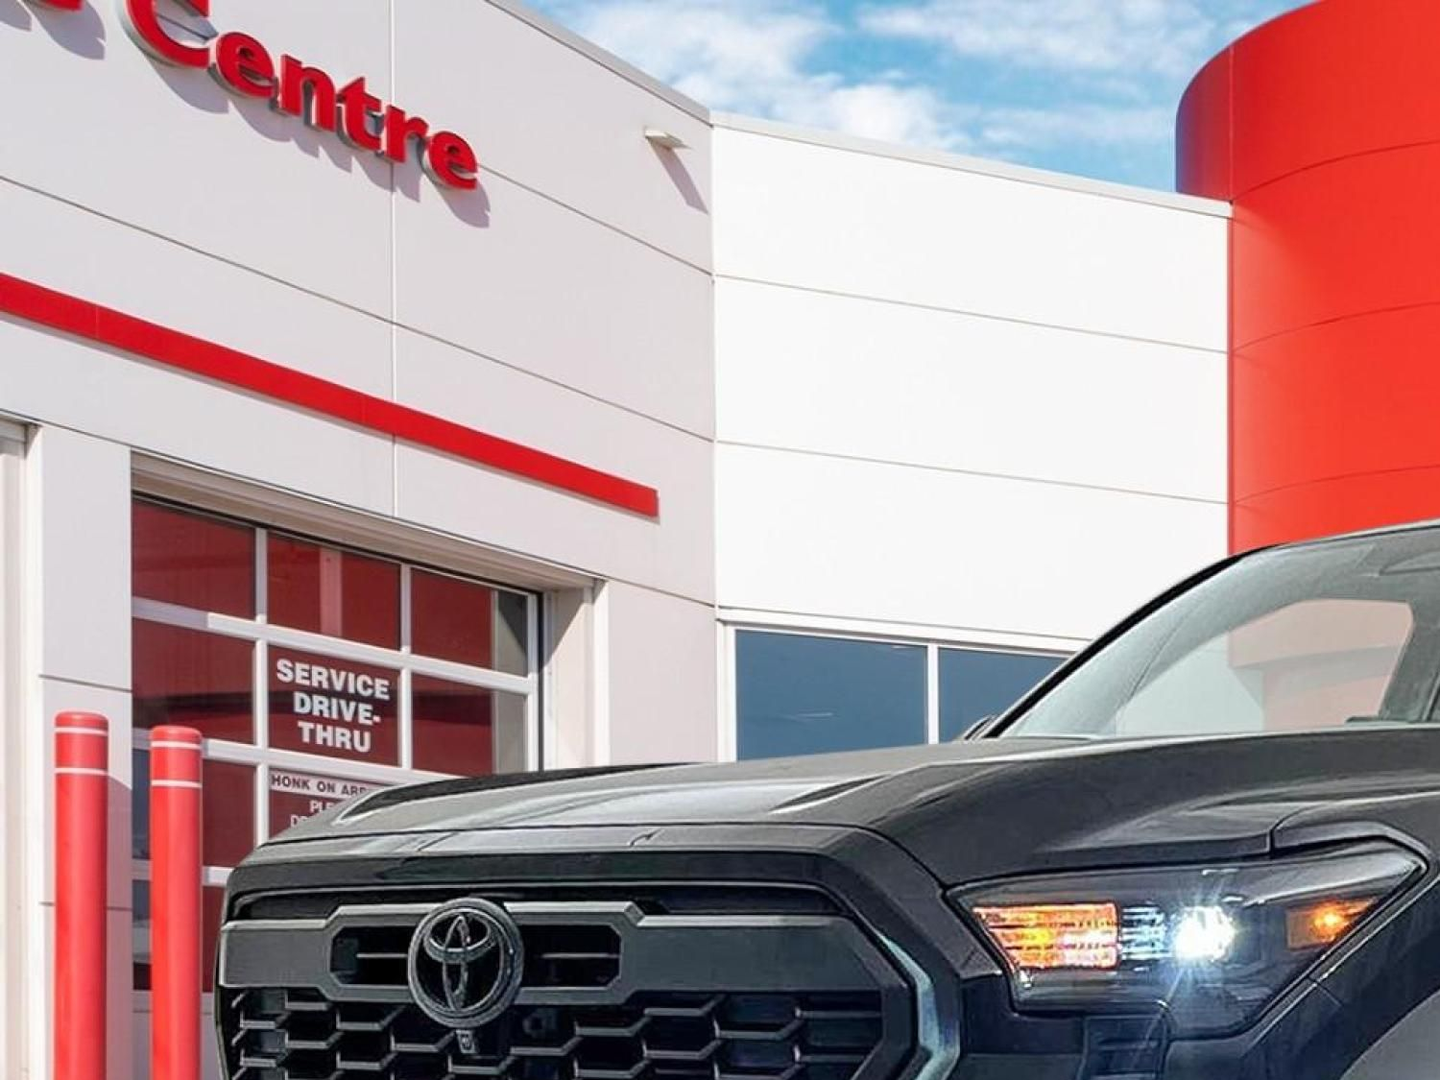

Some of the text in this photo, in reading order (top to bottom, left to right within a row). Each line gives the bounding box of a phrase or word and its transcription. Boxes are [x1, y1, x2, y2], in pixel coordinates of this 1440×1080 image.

[124, 0, 478, 190] Centre
[276, 658, 390, 700] SERVICE
[293, 691, 381, 726] DRIVE-
[297, 720, 371, 753] THRU
[271, 774, 310, 791] HONK
[316, 780, 336, 793] ON
